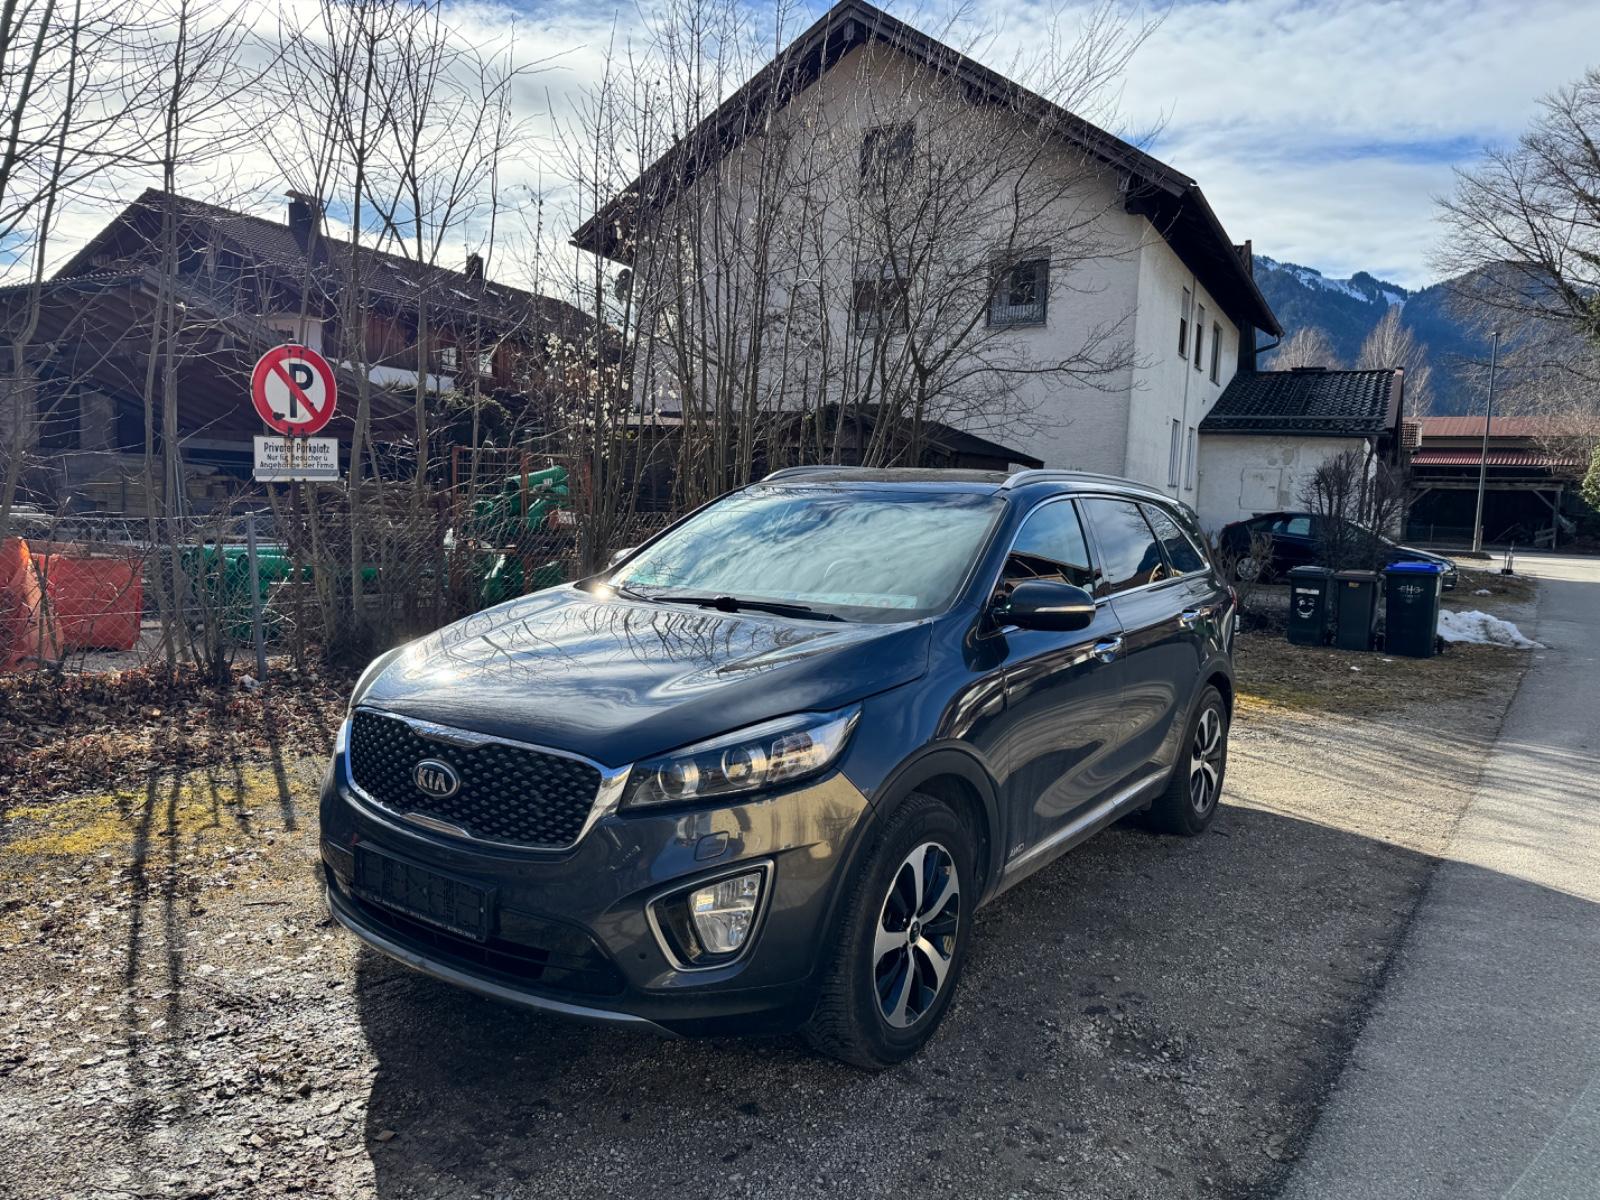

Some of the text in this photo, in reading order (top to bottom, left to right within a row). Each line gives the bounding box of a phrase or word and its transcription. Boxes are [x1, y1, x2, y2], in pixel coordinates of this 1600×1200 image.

[289, 363, 313, 418] P
[264, 442, 330, 454] Privater Parkplatz
[417, 766, 448, 792] KIA
